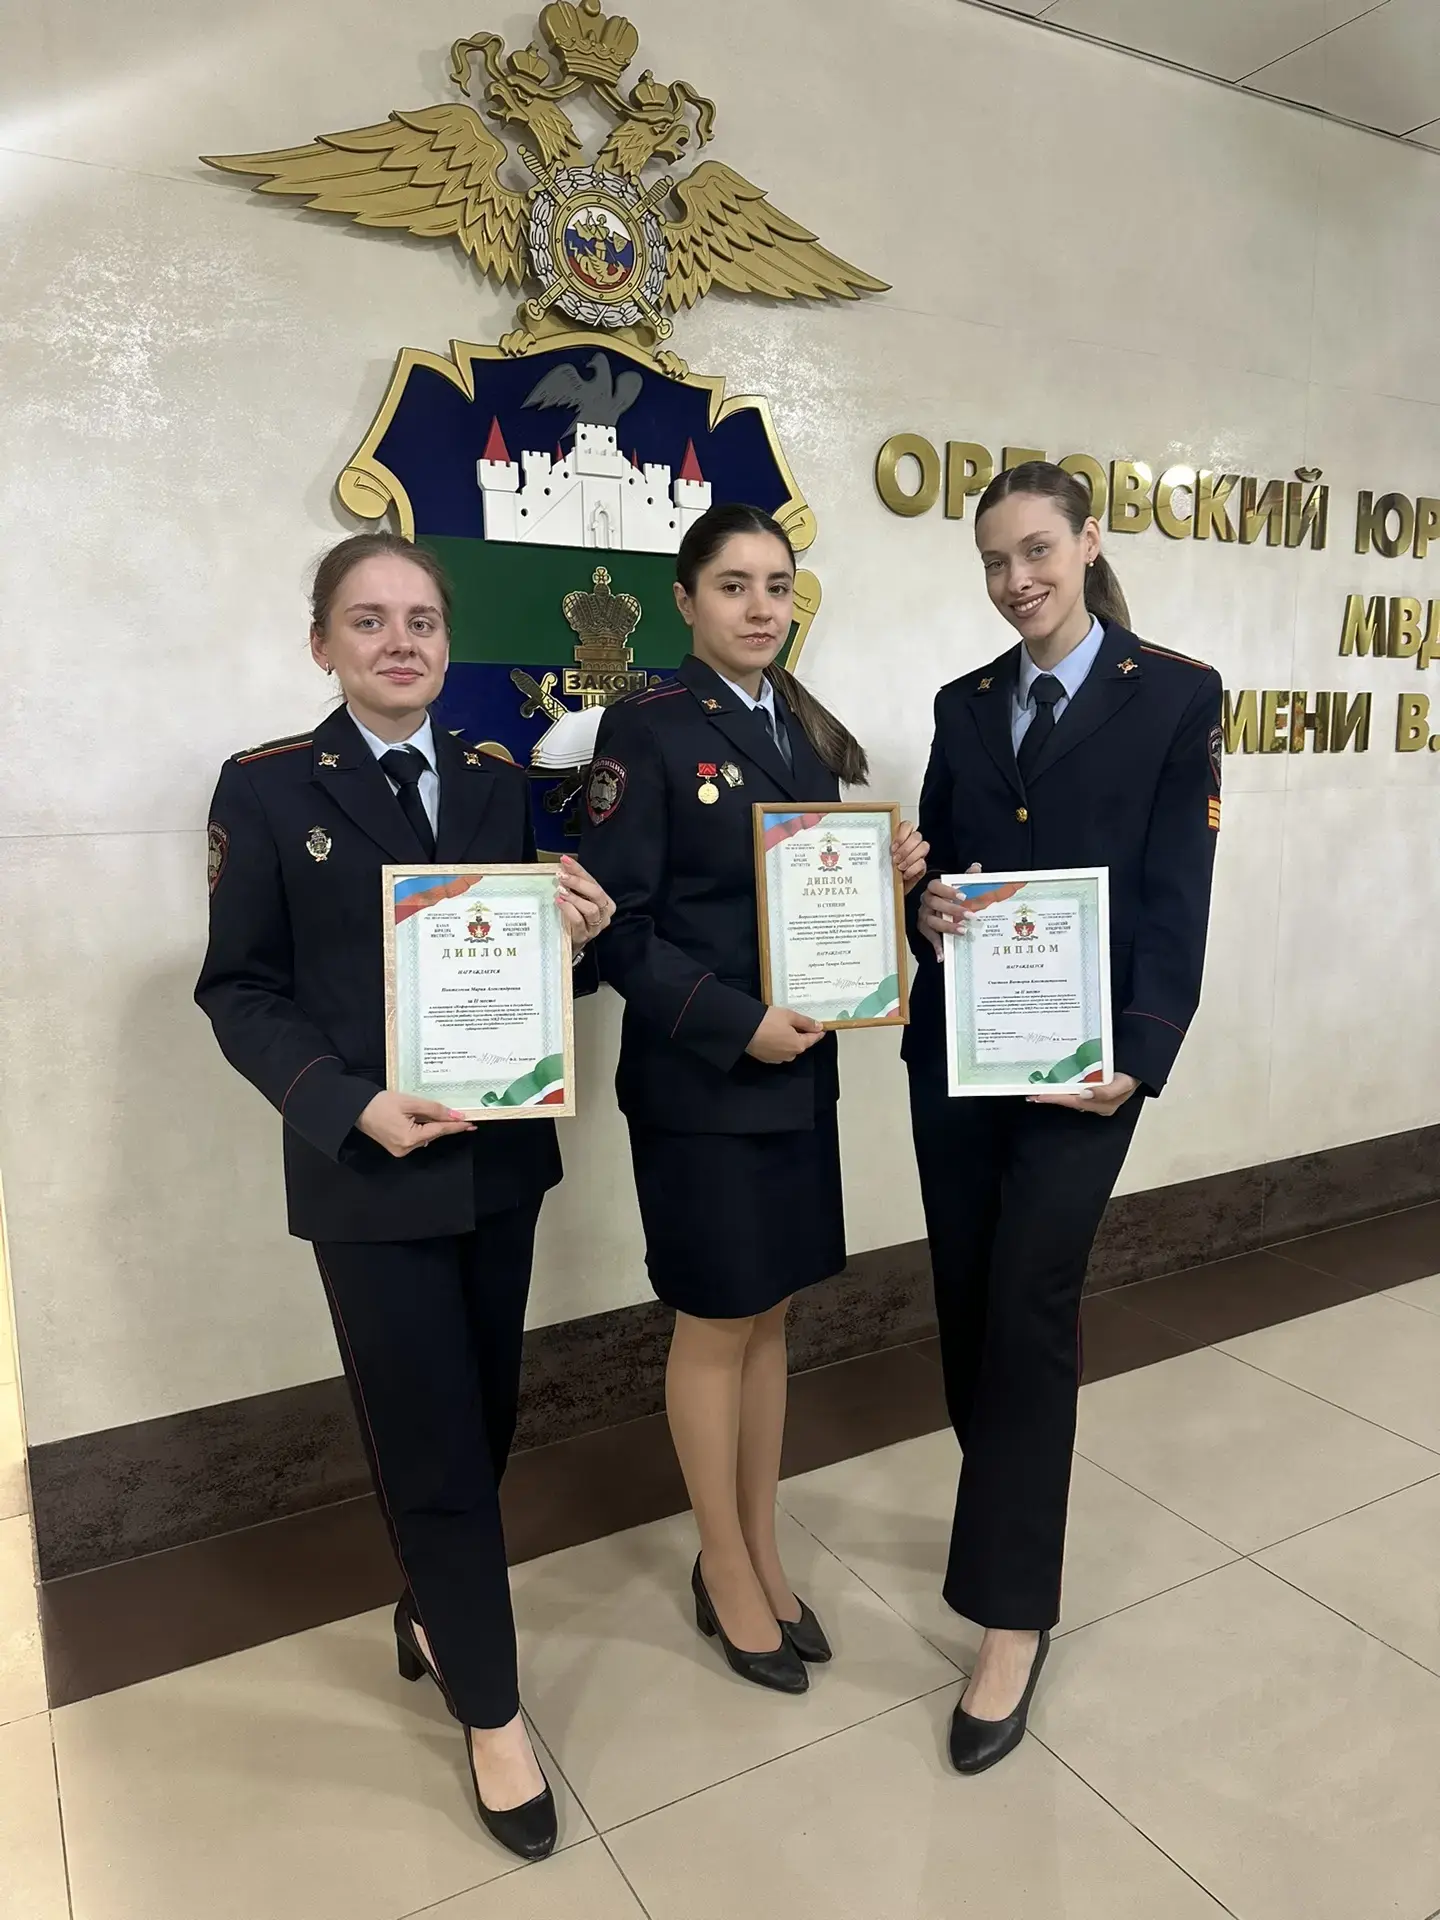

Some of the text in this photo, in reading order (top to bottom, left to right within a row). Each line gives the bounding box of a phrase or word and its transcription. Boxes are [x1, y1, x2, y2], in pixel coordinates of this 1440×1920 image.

[875, 432, 1329, 550] ОРОВСКИЙ
[567, 674, 644, 690] ЗАКОН
[806, 876, 853, 886] ДИПЛОМ
[802, 887, 858, 896] ЛАУРЕАТА
[441, 947, 517, 959] ДИПЛОМ
[992, 944, 1059, 956] ДИПЛОМ
